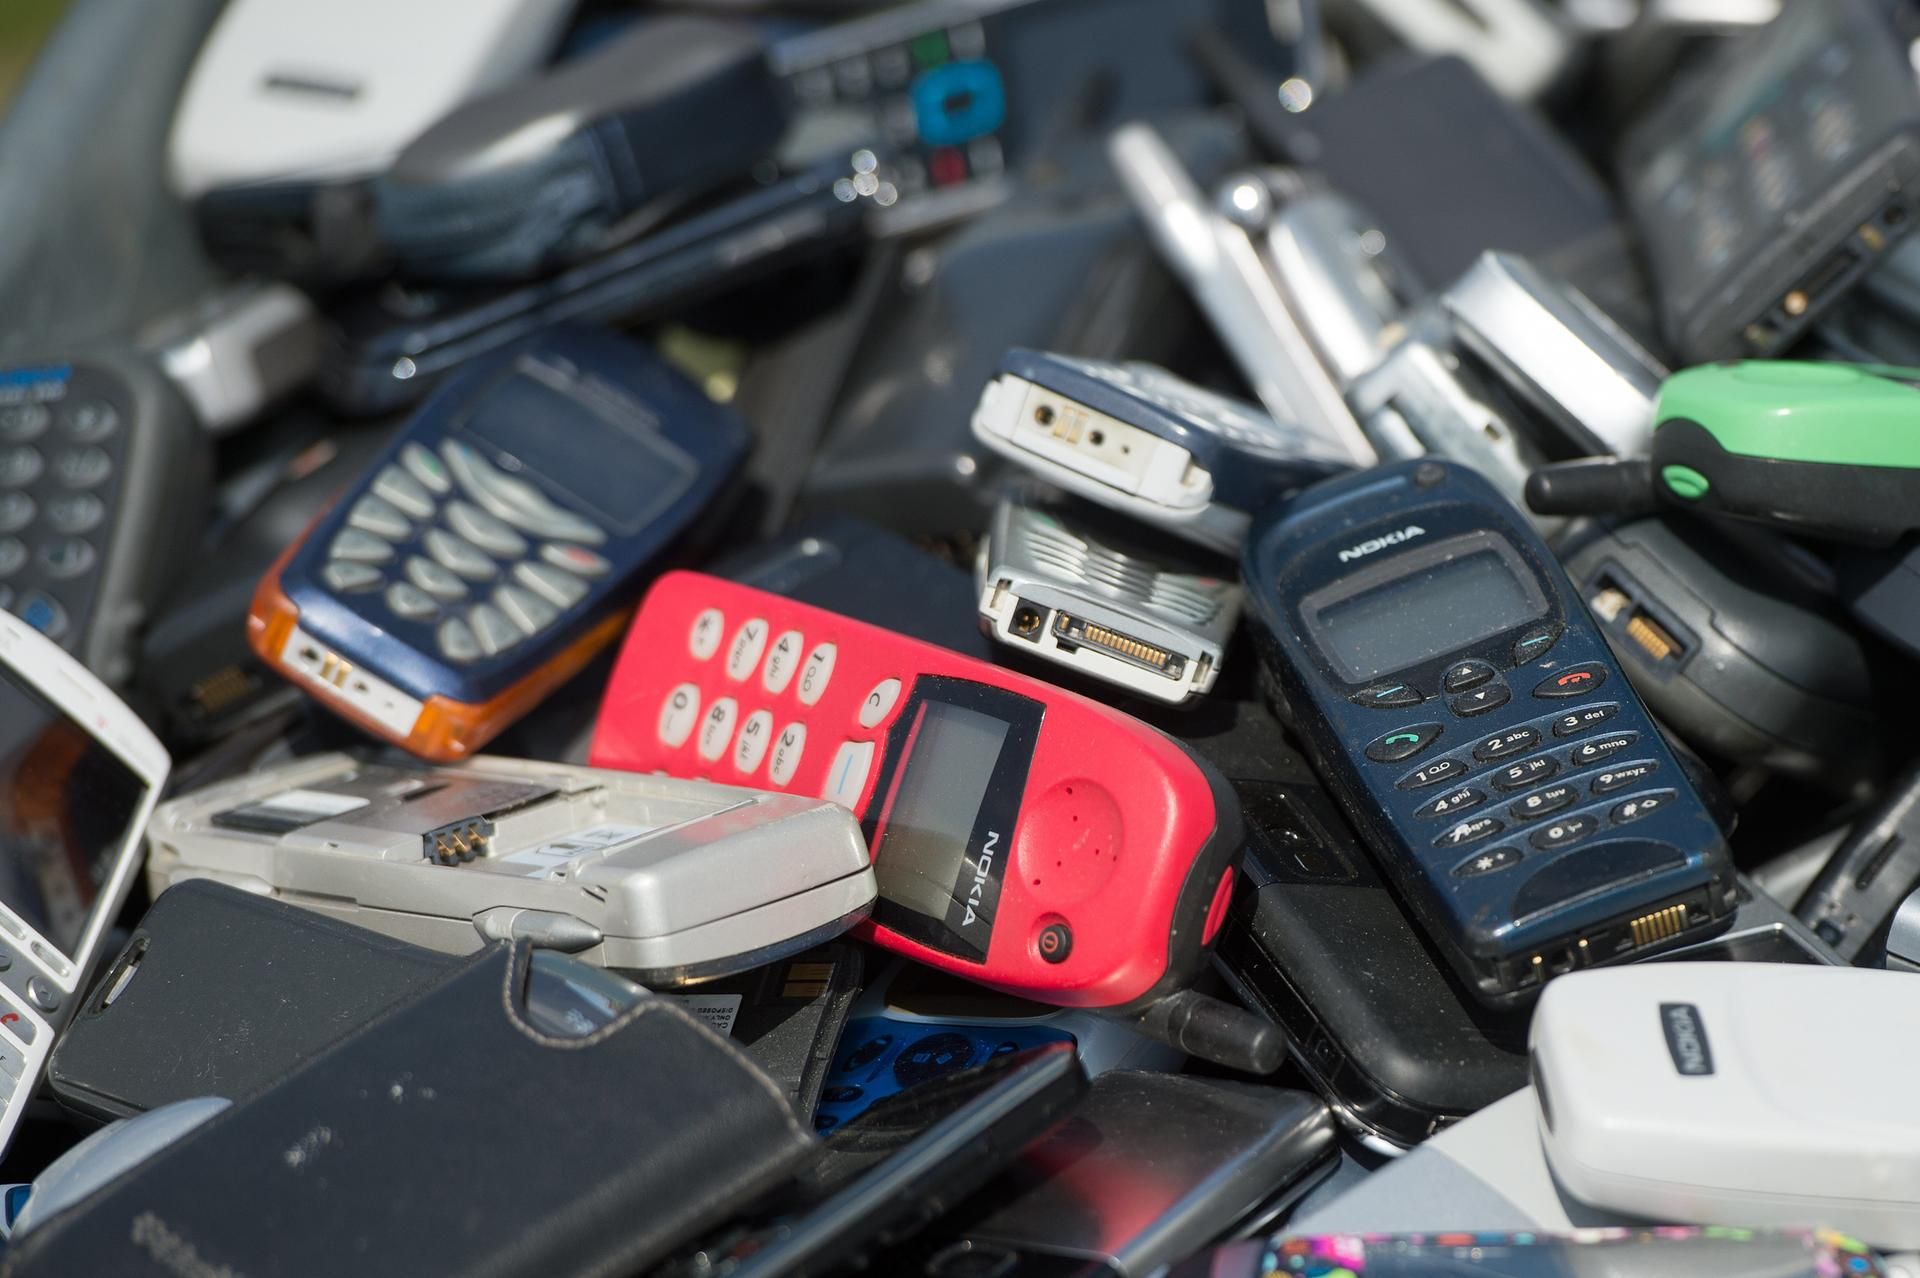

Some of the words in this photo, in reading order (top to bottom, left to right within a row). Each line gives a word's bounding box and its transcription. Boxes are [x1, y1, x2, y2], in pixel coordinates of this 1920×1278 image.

[1338, 525, 1426, 562] NOKIA
[745, 627, 759, 641] 7
[778, 637, 789, 653] 4
[711, 706, 726, 722] 8
[1564, 716, 1579, 727] 3
[1584, 709, 1605, 721] def
[746, 719, 760, 736] 5
[781, 731, 795, 747] 2
[1487, 738, 1504, 751] 2
[1506, 730, 1530, 743] abc
[1582, 744, 1596, 755] 6
[1598, 739, 1628, 751] mno
[1508, 767, 1522, 779] 5
[1528, 759, 1546, 771] jkl
[1599, 773, 1613, 784] 9
[1615, 766, 1648, 779] wxyz
[1434, 800, 1449, 812] 4
[1451, 789, 1471, 804] ghi
[1526, 796, 1542, 808] 8
[1545, 787, 1566, 800] tuv
[962, 830, 1000, 926] NOKIA
[1669, 1006, 1706, 1073] NOKIA
